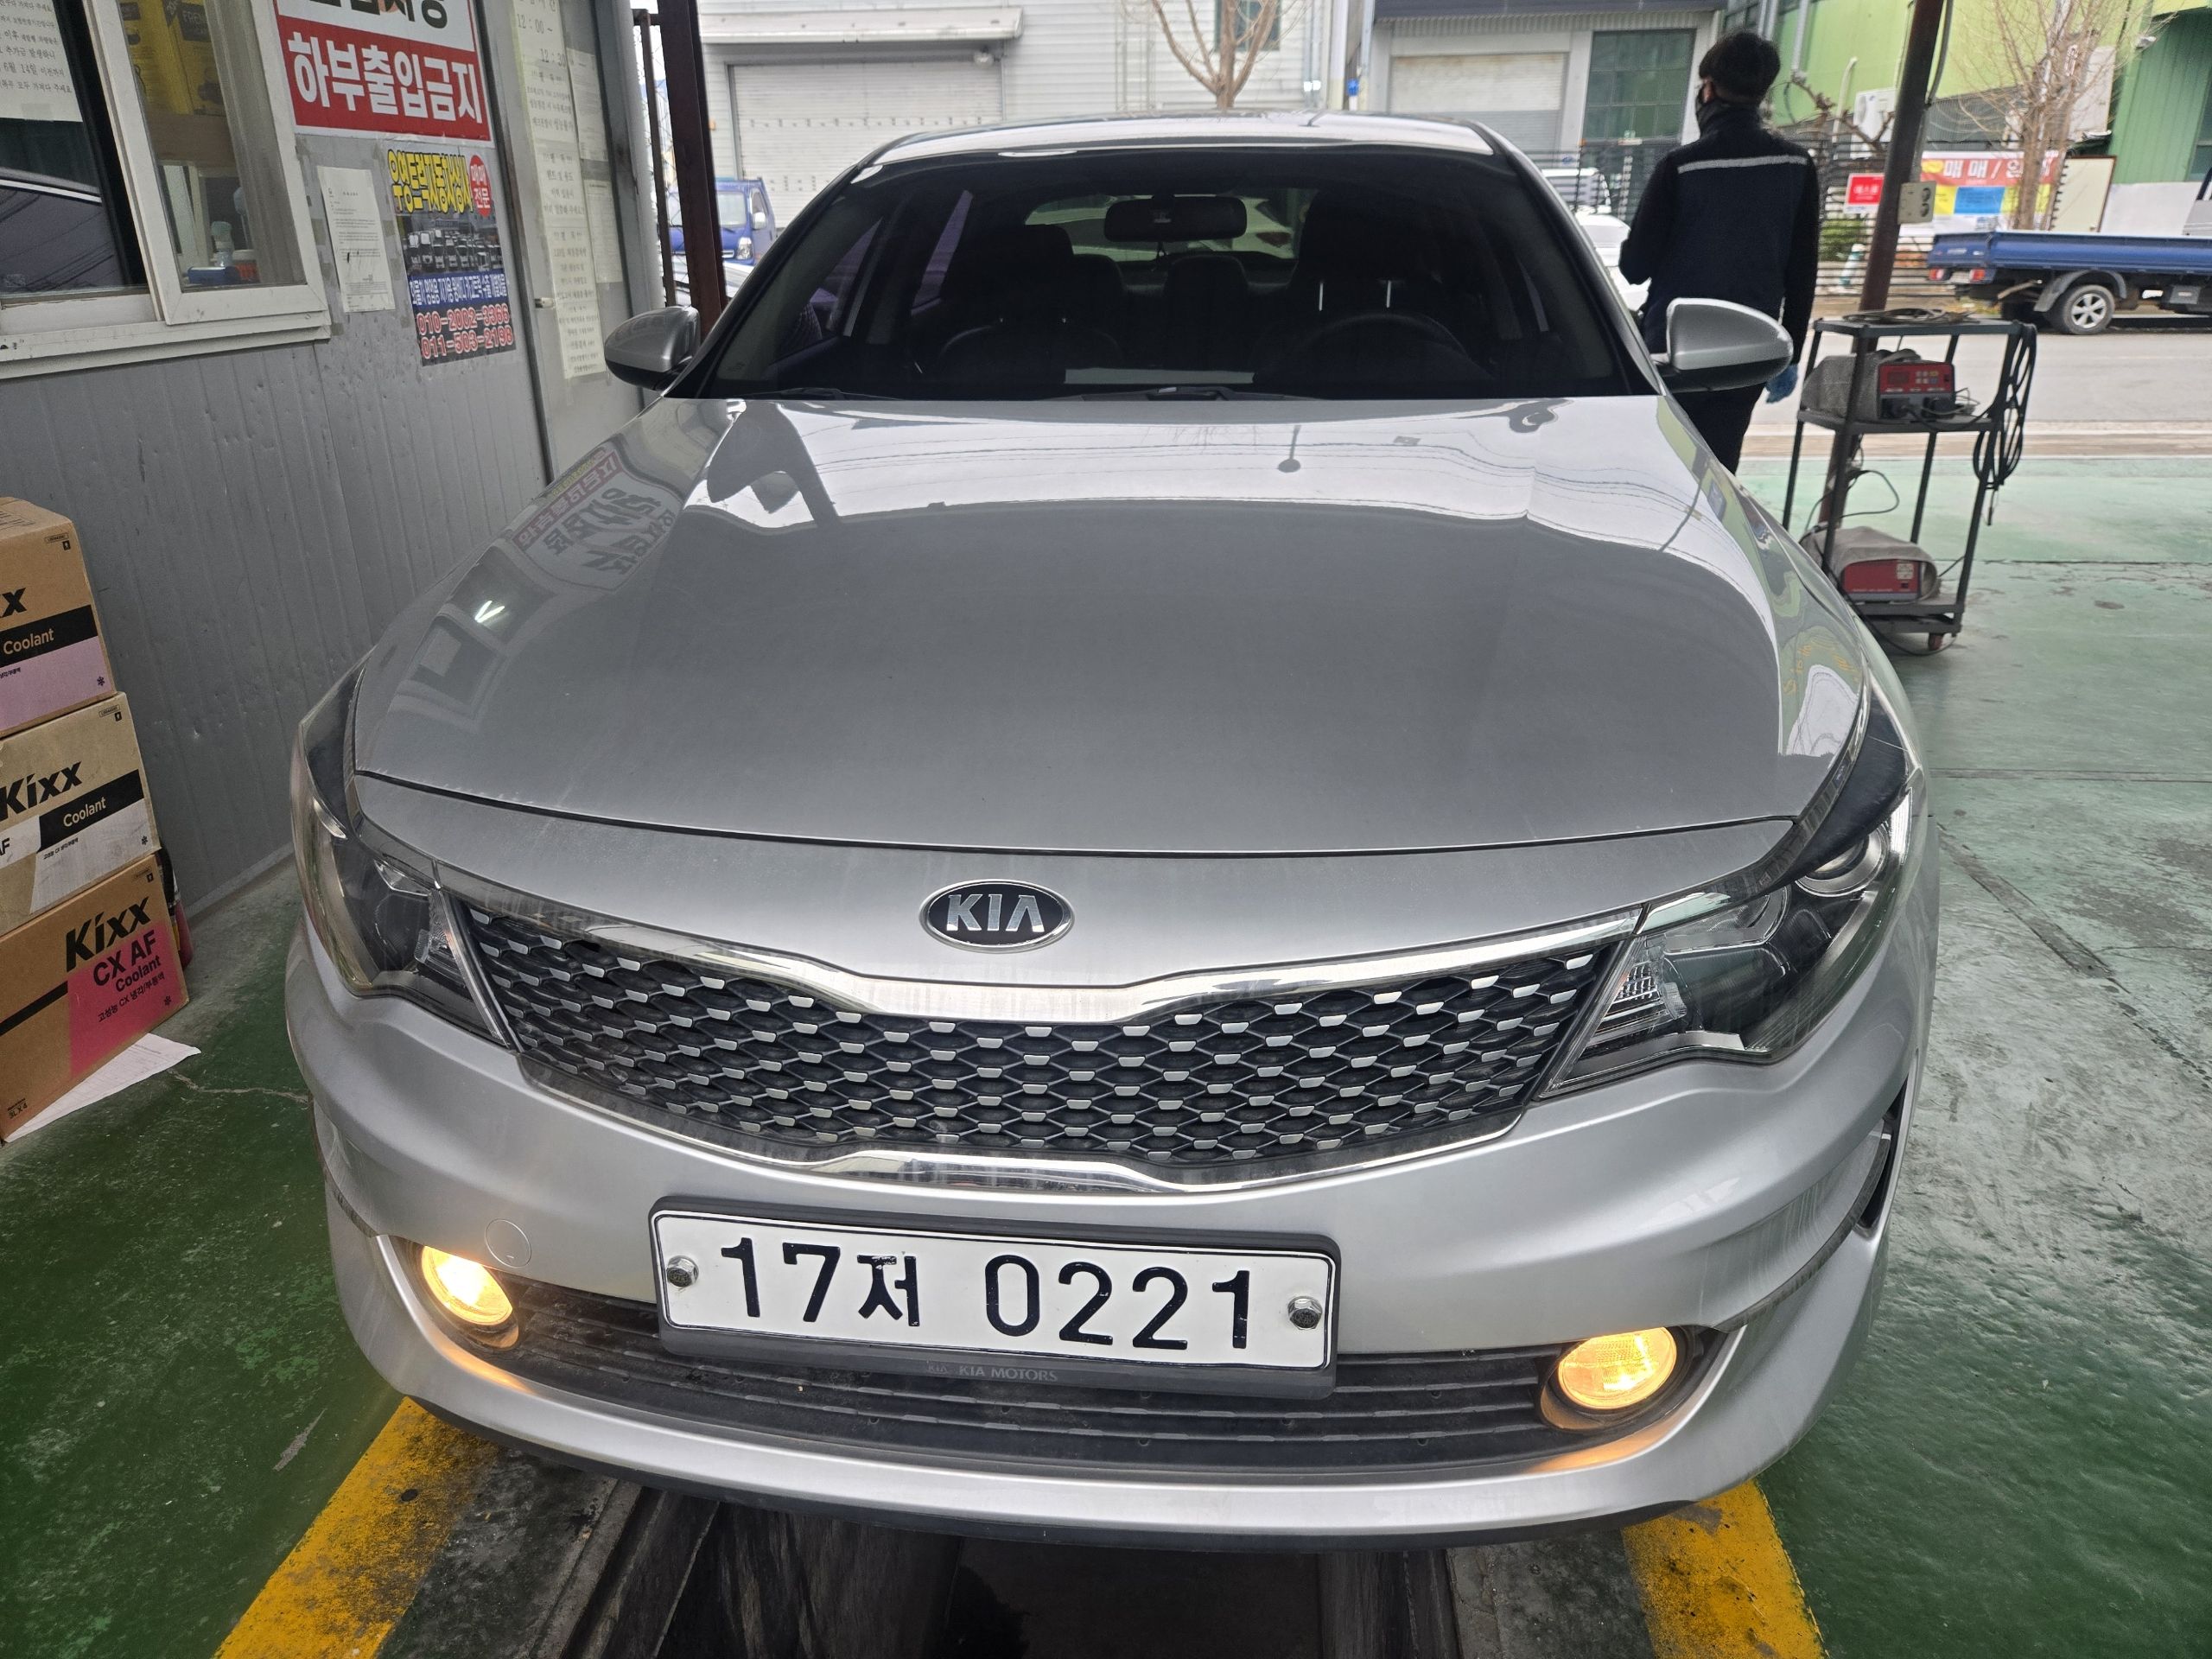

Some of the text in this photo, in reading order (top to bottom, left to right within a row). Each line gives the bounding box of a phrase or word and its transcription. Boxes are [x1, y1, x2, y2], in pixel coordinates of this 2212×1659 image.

[288, 31, 482, 124] 하부출입금지
[3, 627, 54, 655] Coolant
[0, 761, 82, 821] Kixx
[63, 796, 106, 828] Coolant
[67, 896, 151, 973] Kixx
[946, 893, 1045, 933] KIA
[93, 929, 156, 986] CX AF
[116, 955, 162, 992] Coolant
[98, 971, 165, 1022] 고성능 CX 냉각/부동액
[721, 1236, 1251, 1350] 17저 0221
[959, 1365, 985, 1376] KIA
[991, 1367, 1058, 1382] MOTORS
